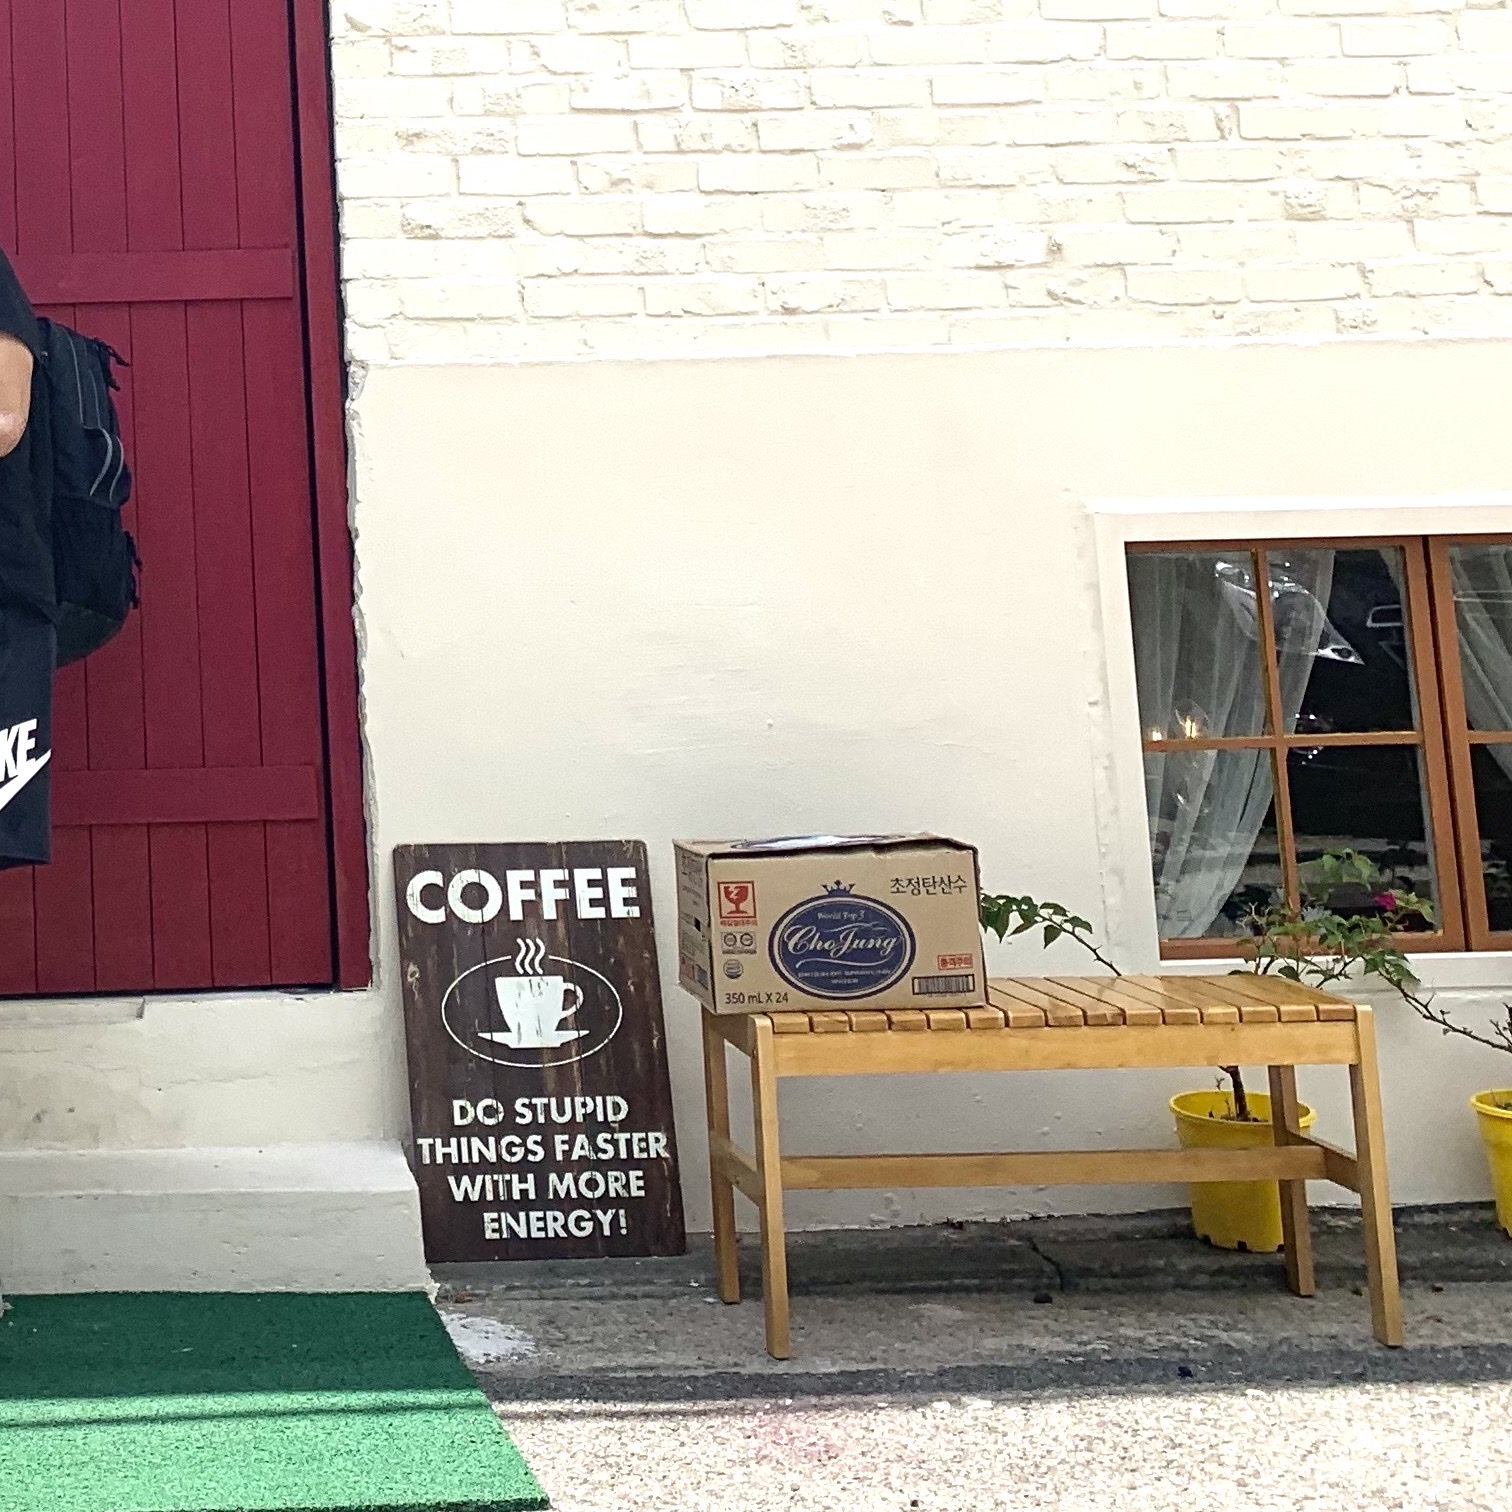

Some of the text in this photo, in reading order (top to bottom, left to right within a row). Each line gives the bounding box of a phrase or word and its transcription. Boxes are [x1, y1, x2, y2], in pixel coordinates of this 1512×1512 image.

[405, 866, 642, 924] COFFEE
[889, 874, 968, 897] 초정탄산수
[784, 925, 898, 958] ChoJung
[724, 991, 746, 1005] 350
[748, 991, 763, 1004] mL
[775, 991, 789, 1004] 24
[451, 1094, 629, 1127] DO STUPID
[416, 1131, 671, 1165] THINGS FASTER
[447, 1170, 646, 1203] WITH MORE
[483, 1208, 628, 1240] ENERGY!
